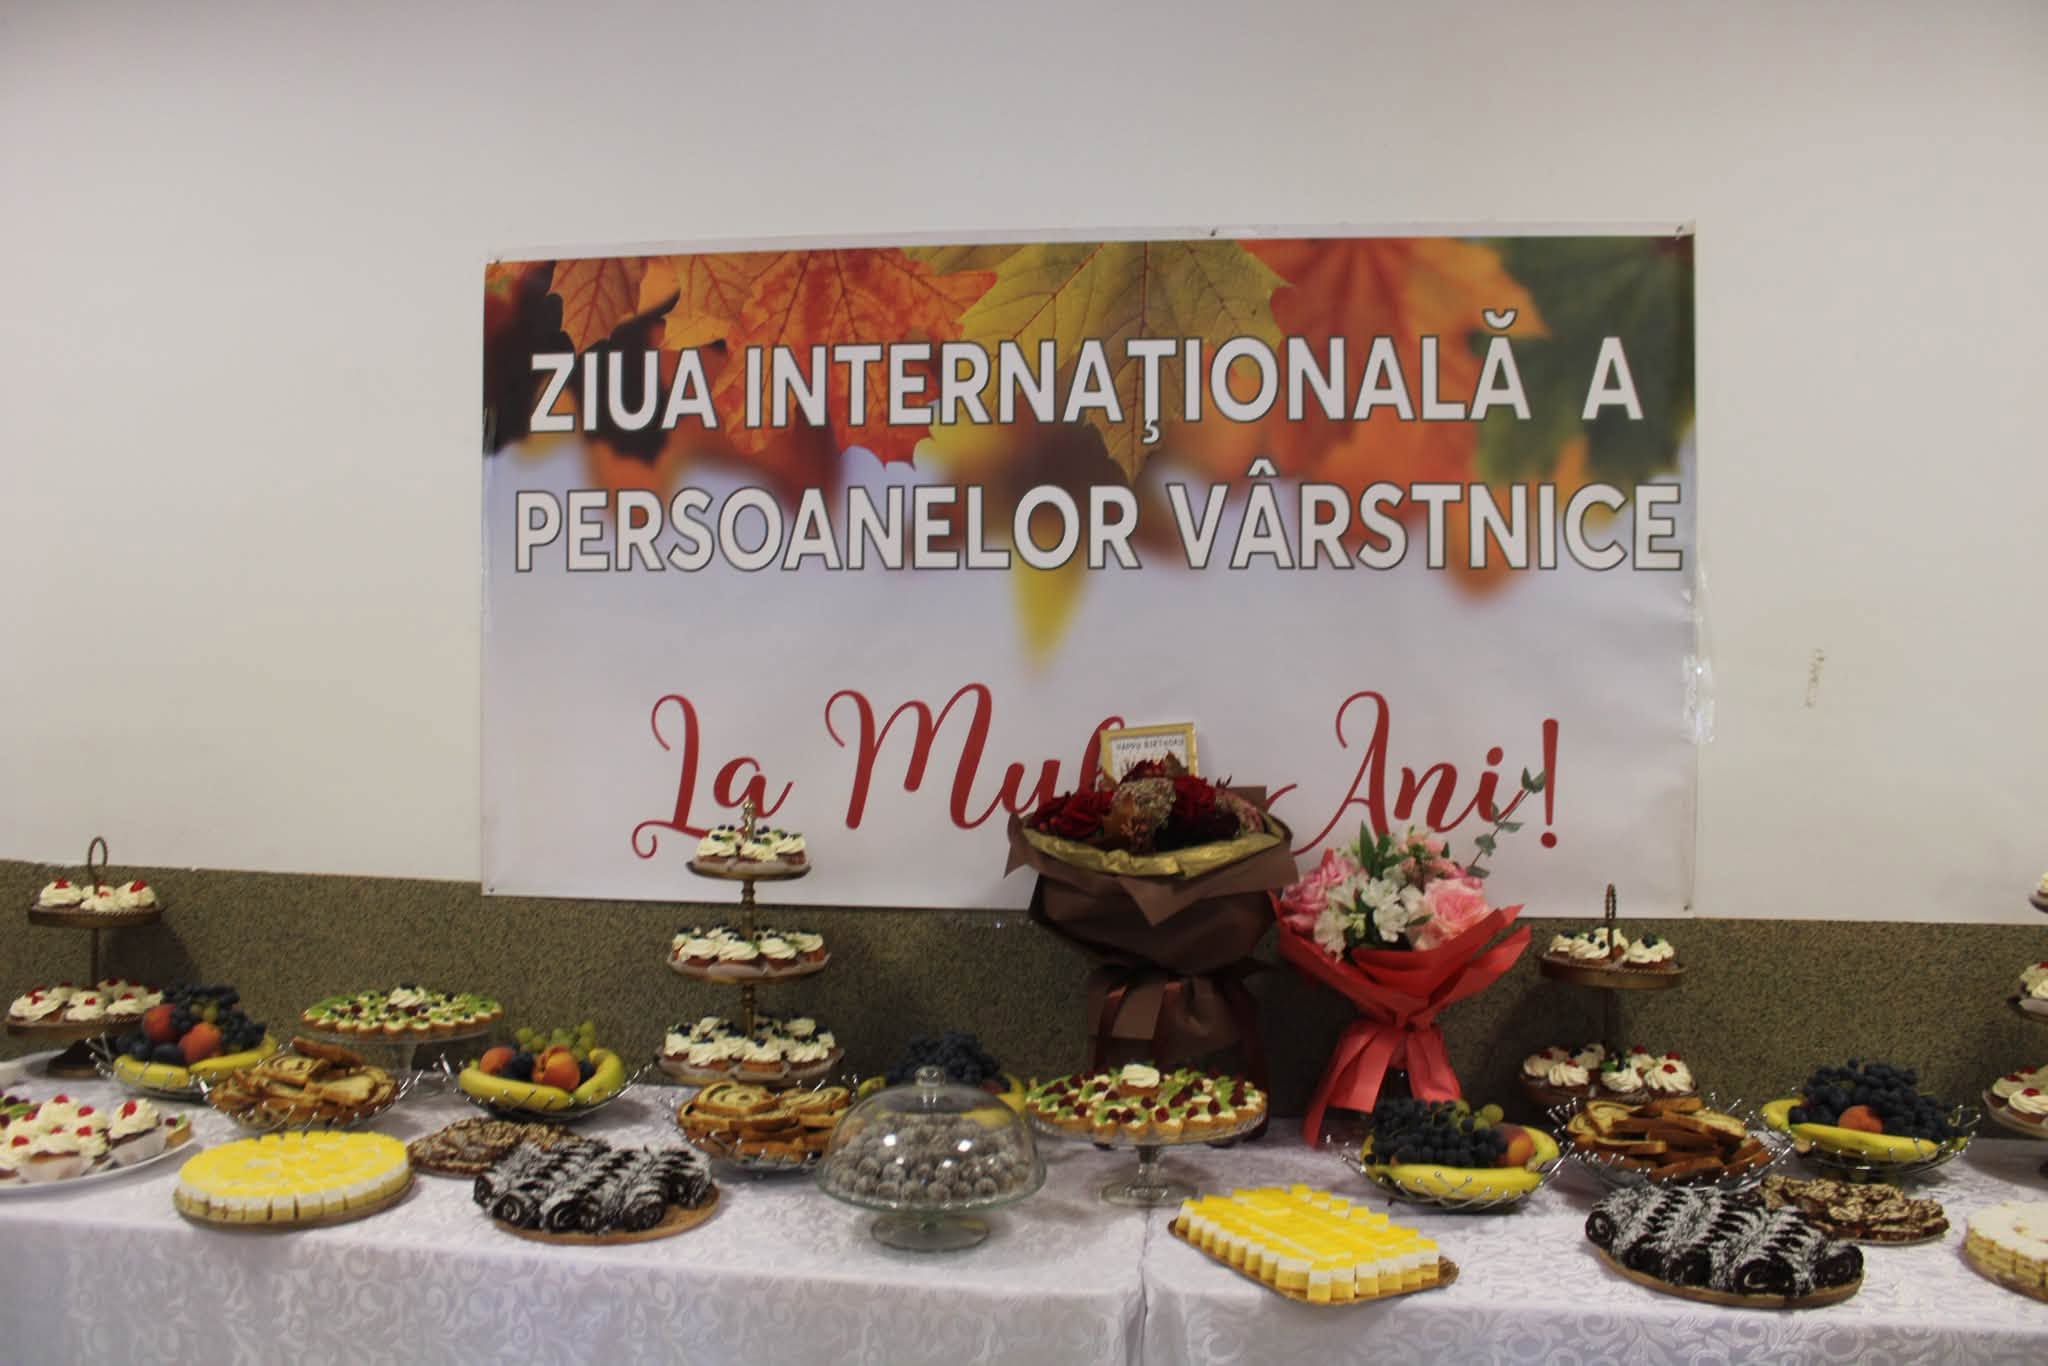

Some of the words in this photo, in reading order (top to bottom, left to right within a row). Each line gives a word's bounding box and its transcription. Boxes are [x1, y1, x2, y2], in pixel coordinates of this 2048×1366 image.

[529, 347, 718, 433] ZIUA
[1581, 336, 1644, 421] A
[515, 484, 1143, 573] PERSOANELOR
[1165, 457, 1684, 571] VÂRSTNICE
[632, 694, 794, 859] La
[824, 683, 1298, 830] Mul
[1293, 690, 1559, 856] Ani!
